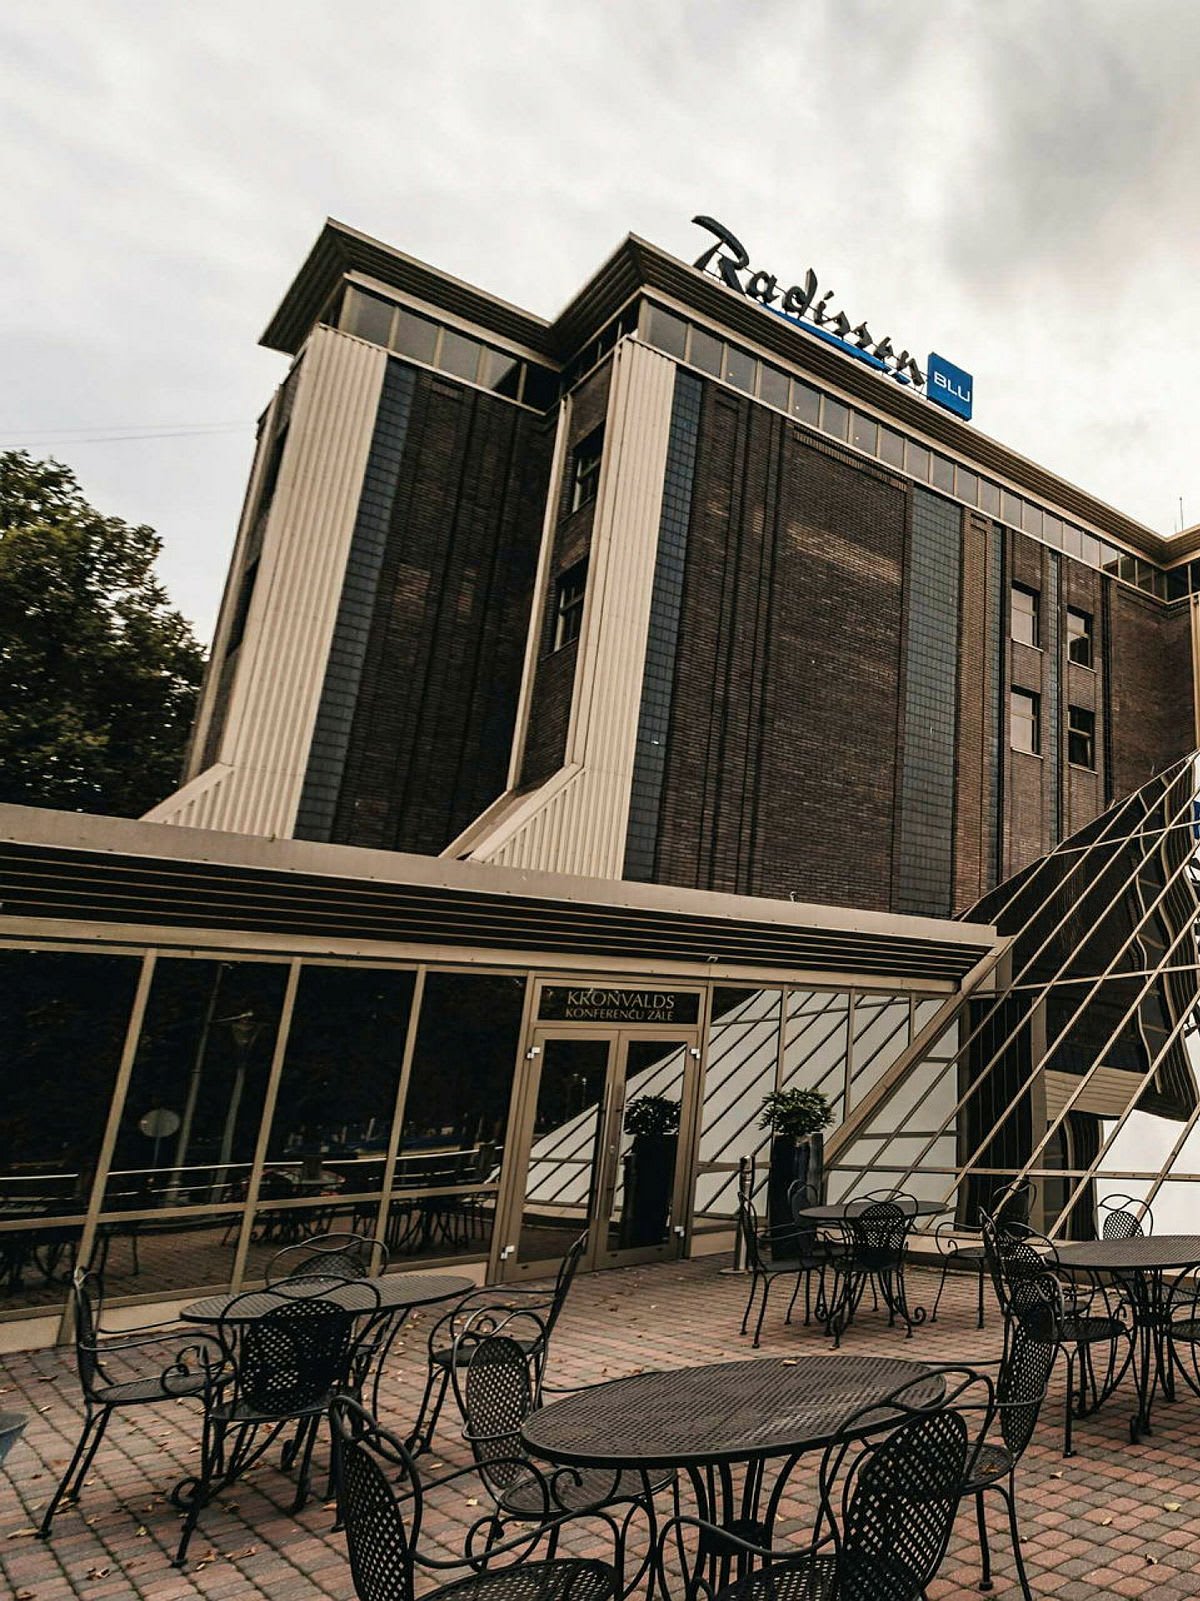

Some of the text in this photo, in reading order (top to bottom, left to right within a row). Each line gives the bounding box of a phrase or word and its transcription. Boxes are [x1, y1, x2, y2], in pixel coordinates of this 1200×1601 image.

[691, 215, 970, 403] Radisson BLU
[567, 989, 675, 1009] KRONVALDS
